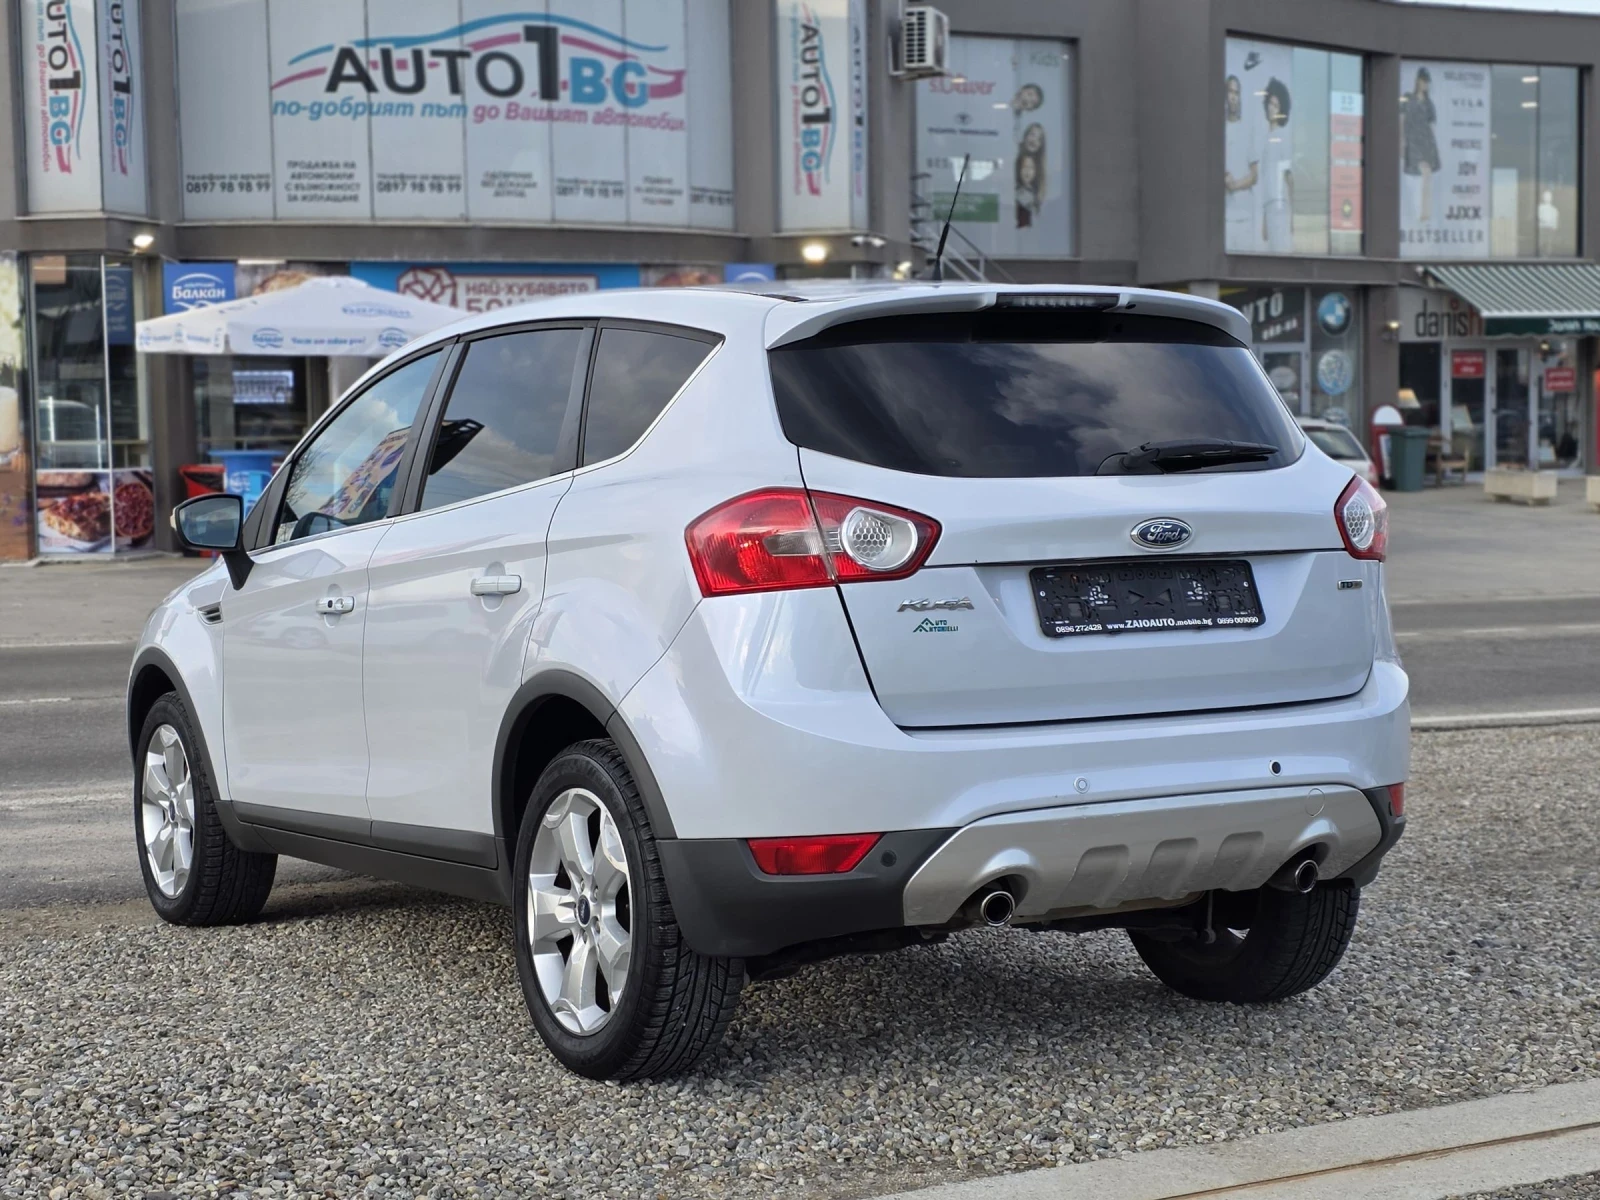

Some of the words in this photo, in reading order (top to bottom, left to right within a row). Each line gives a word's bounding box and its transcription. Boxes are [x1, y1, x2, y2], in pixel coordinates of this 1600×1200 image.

[273, 97, 413, 121] по-добрият
[421, 102, 468, 118] път
[473, 104, 500, 124] до
[505, 102, 588, 123] Вашият
[1452, 98, 1484, 108] VILA
[186, 182, 216, 193] 0897
[219, 182, 234, 193] 98
[238, 182, 253, 193] 98
[256, 181, 271, 192] 99
[1445, 206, 1481, 220] JJXX
[172, 285, 226, 300] Балкан
[1147, 522, 1181, 541] Ford
[897, 597, 975, 612] KUGA
